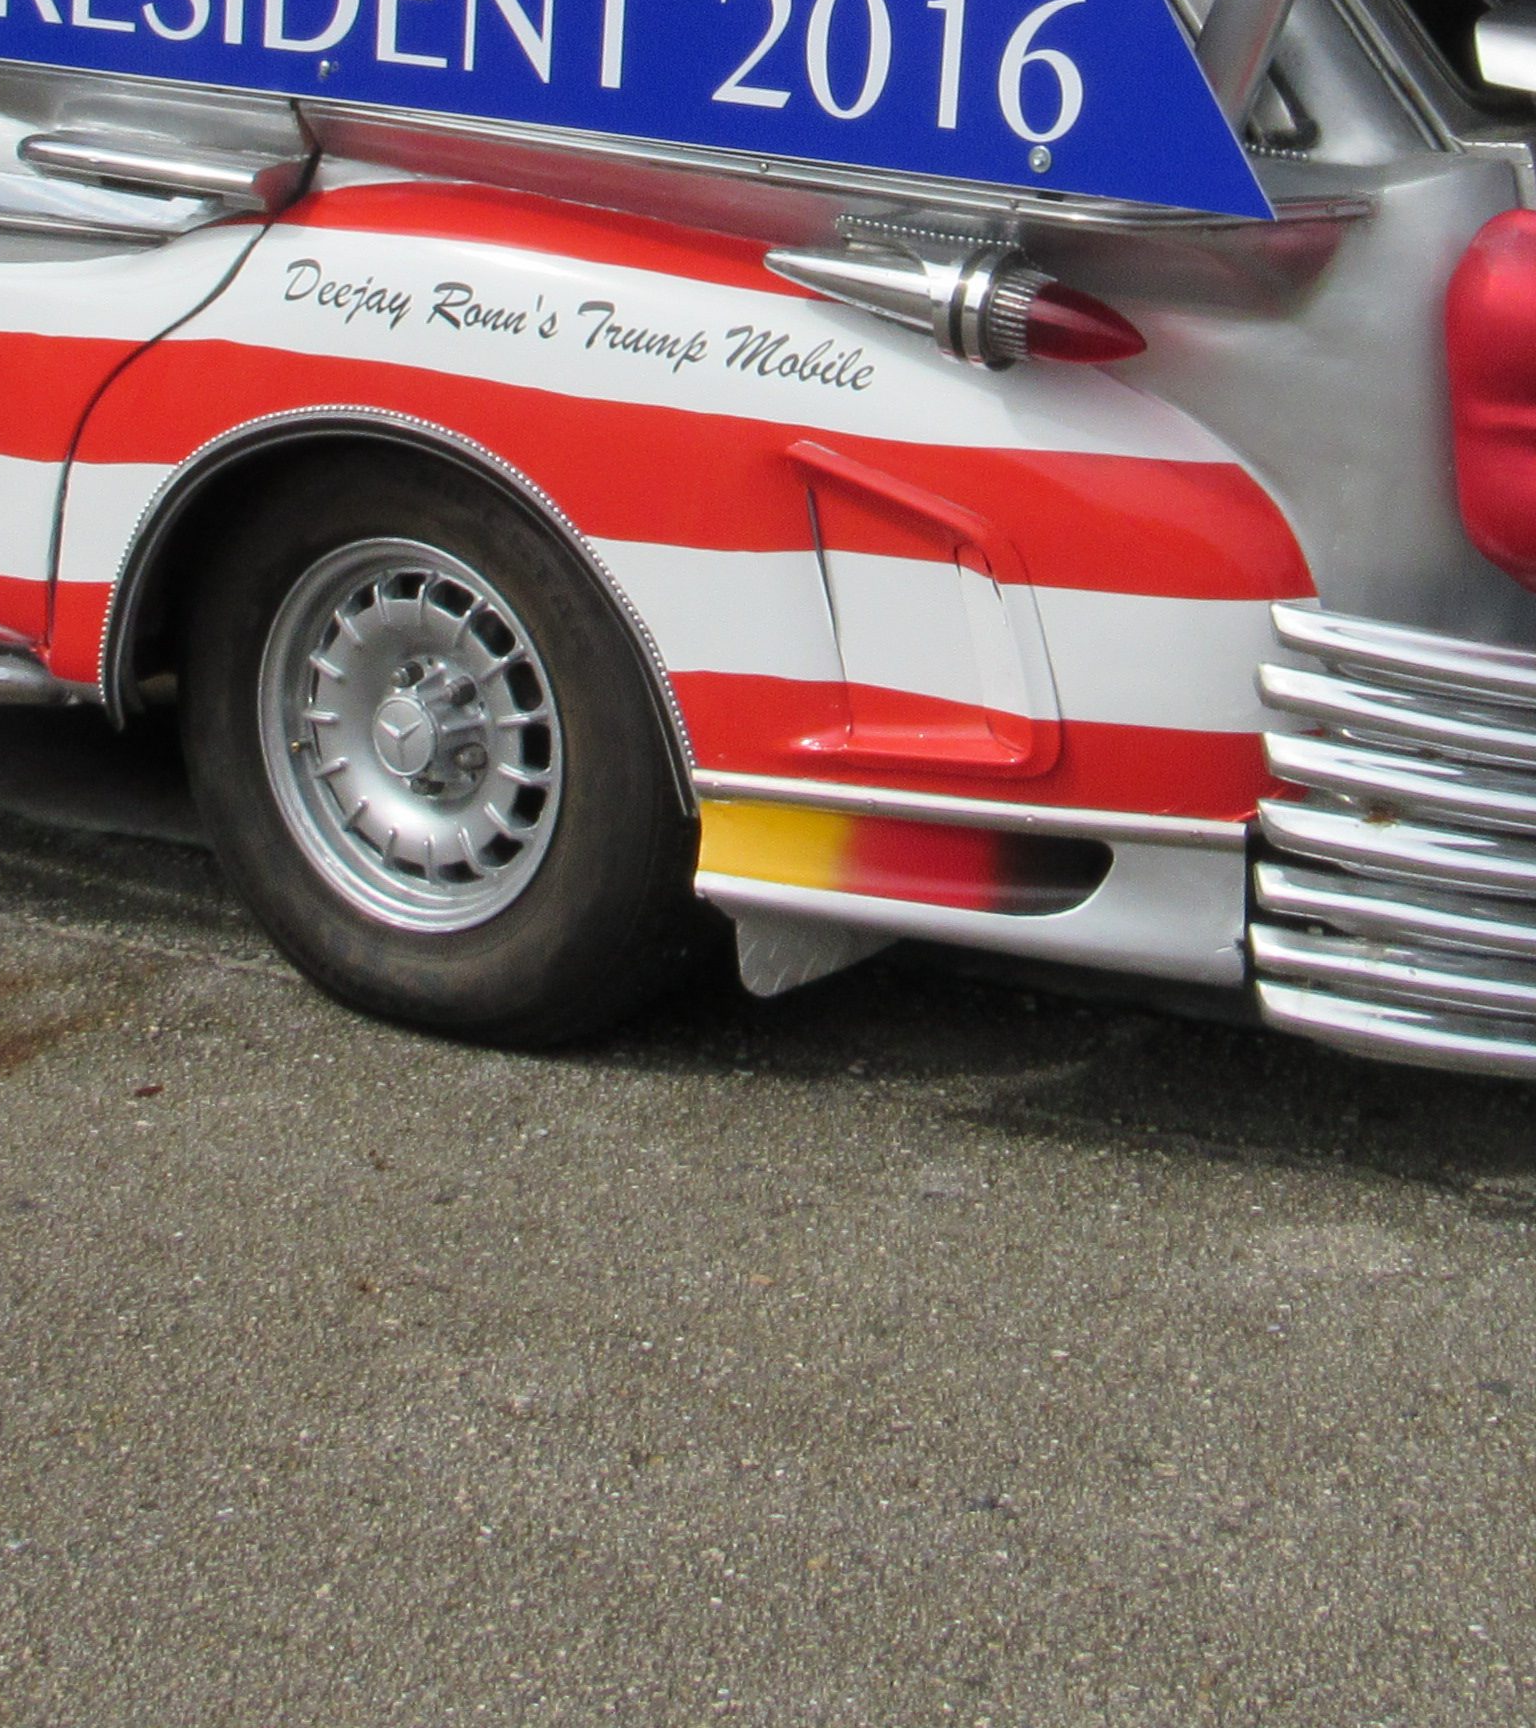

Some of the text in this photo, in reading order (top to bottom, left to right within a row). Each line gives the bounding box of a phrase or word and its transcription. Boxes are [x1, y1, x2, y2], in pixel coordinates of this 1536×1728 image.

[284, 258, 875, 392] Deejay Ronn's Trump Mobile
